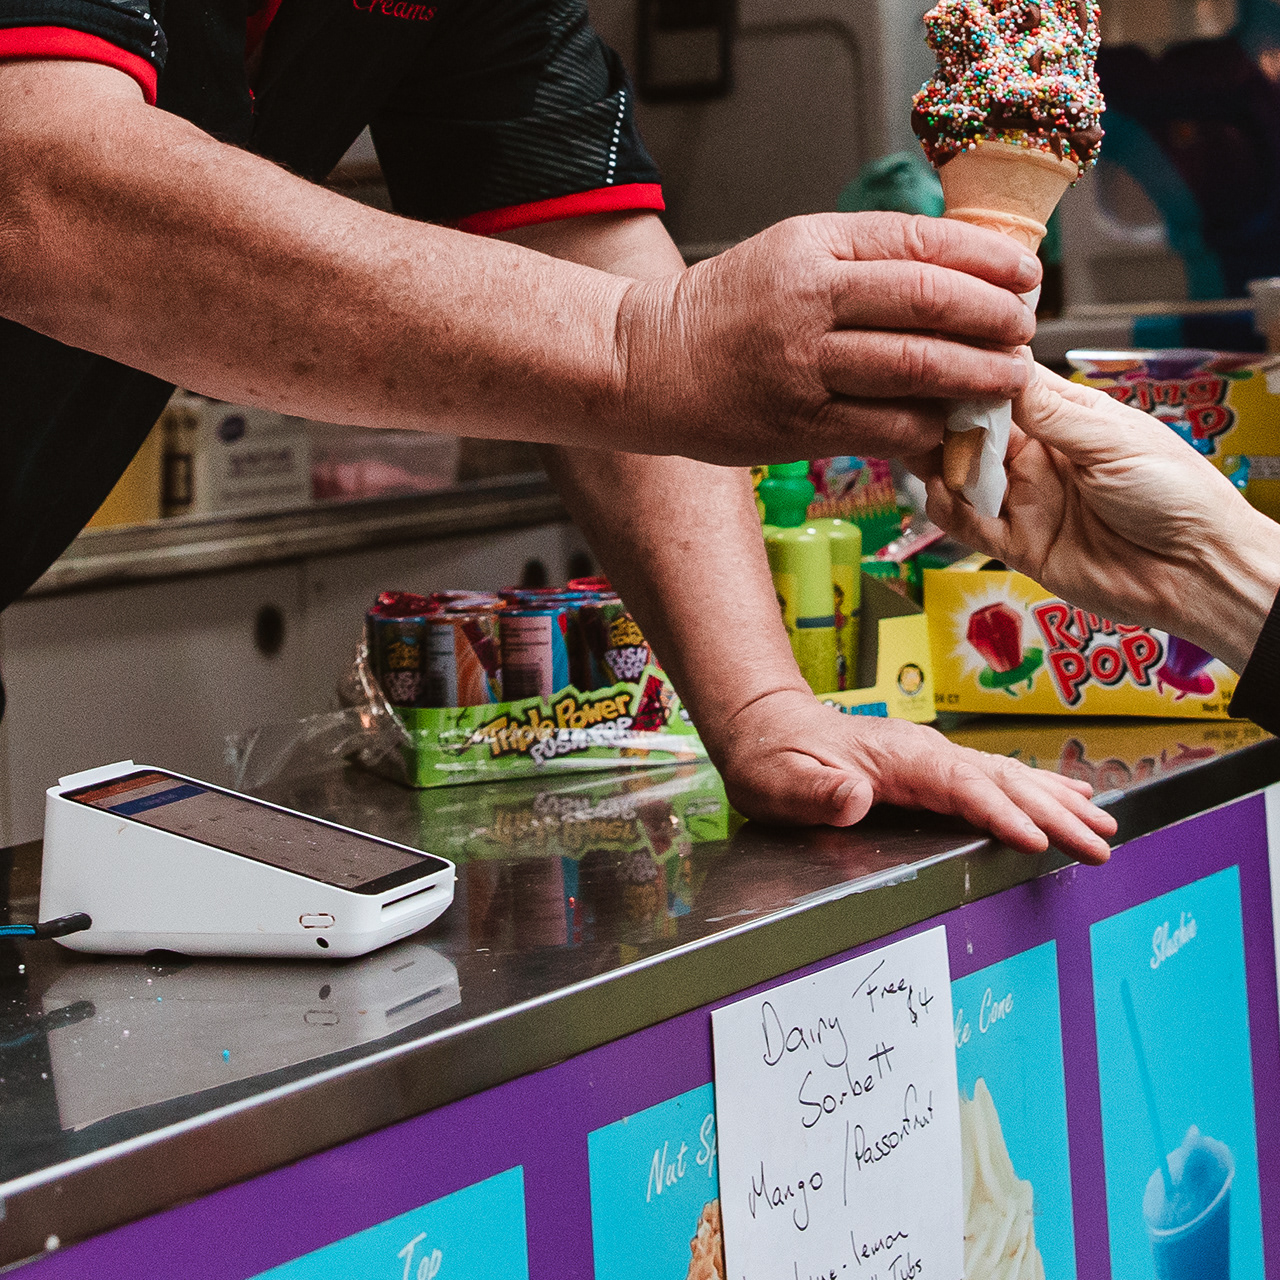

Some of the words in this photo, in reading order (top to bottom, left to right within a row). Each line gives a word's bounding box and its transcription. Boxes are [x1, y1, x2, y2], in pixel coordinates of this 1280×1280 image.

[555, 694, 631, 730] Power
[762, 1001, 848, 1068] Dairy
[979, 988, 1014, 1033] Cone
[646, 1140, 689, 1204] Nut
[748, 1160, 823, 1231] Mango
